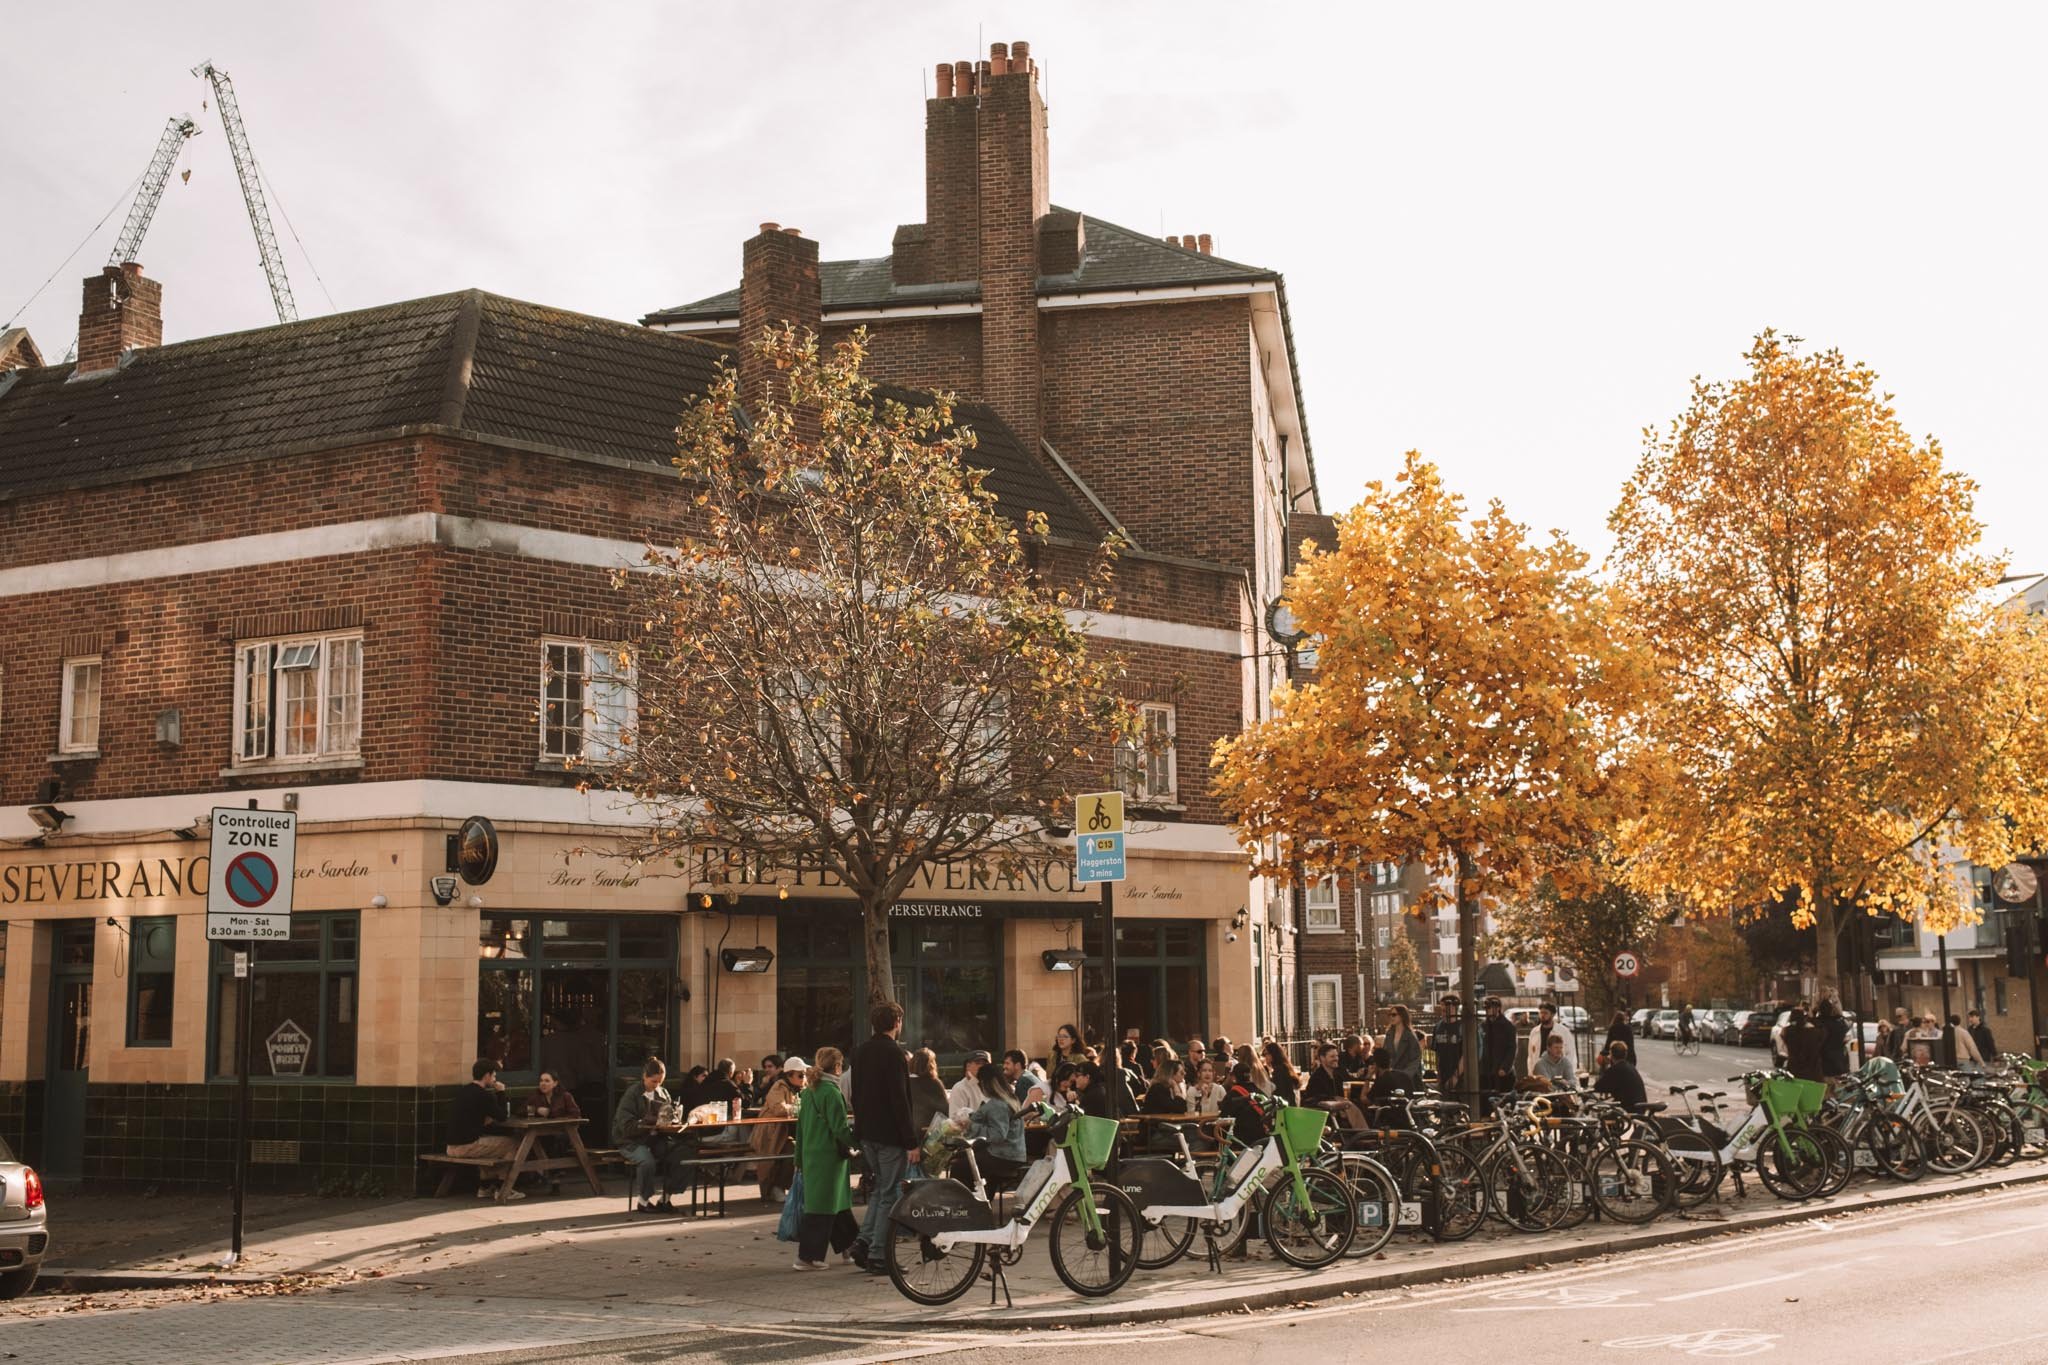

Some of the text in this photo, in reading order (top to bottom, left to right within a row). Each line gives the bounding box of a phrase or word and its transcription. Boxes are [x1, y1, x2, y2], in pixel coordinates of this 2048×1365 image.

[218, 814, 290, 829] Controlled
[228, 831, 279, 847] ZONE
[1097, 840, 1113, 849] C13
[293, 859, 369, 879] eer Garden
[1080, 857, 1122, 868] Haggerston
[2, 856, 210, 903] SEVERANC
[547, 869, 586, 886] Beer
[1089, 870, 1095, 878] 3
[1123, 884, 1183, 900] Beer Garden
[230, 916, 249, 926] Mon
[255, 917, 270, 926] Sat
[211, 928, 232, 936] 8.30
[252, 928, 273, 937] 5.30
[274, 930, 287, 938] pm
[1616, 959, 1635, 970] 20
[1237, 1166, 1267, 1201] Lime
[1029, 1182, 1058, 1220] Lime
[1363, 1204, 1379, 1225] P
